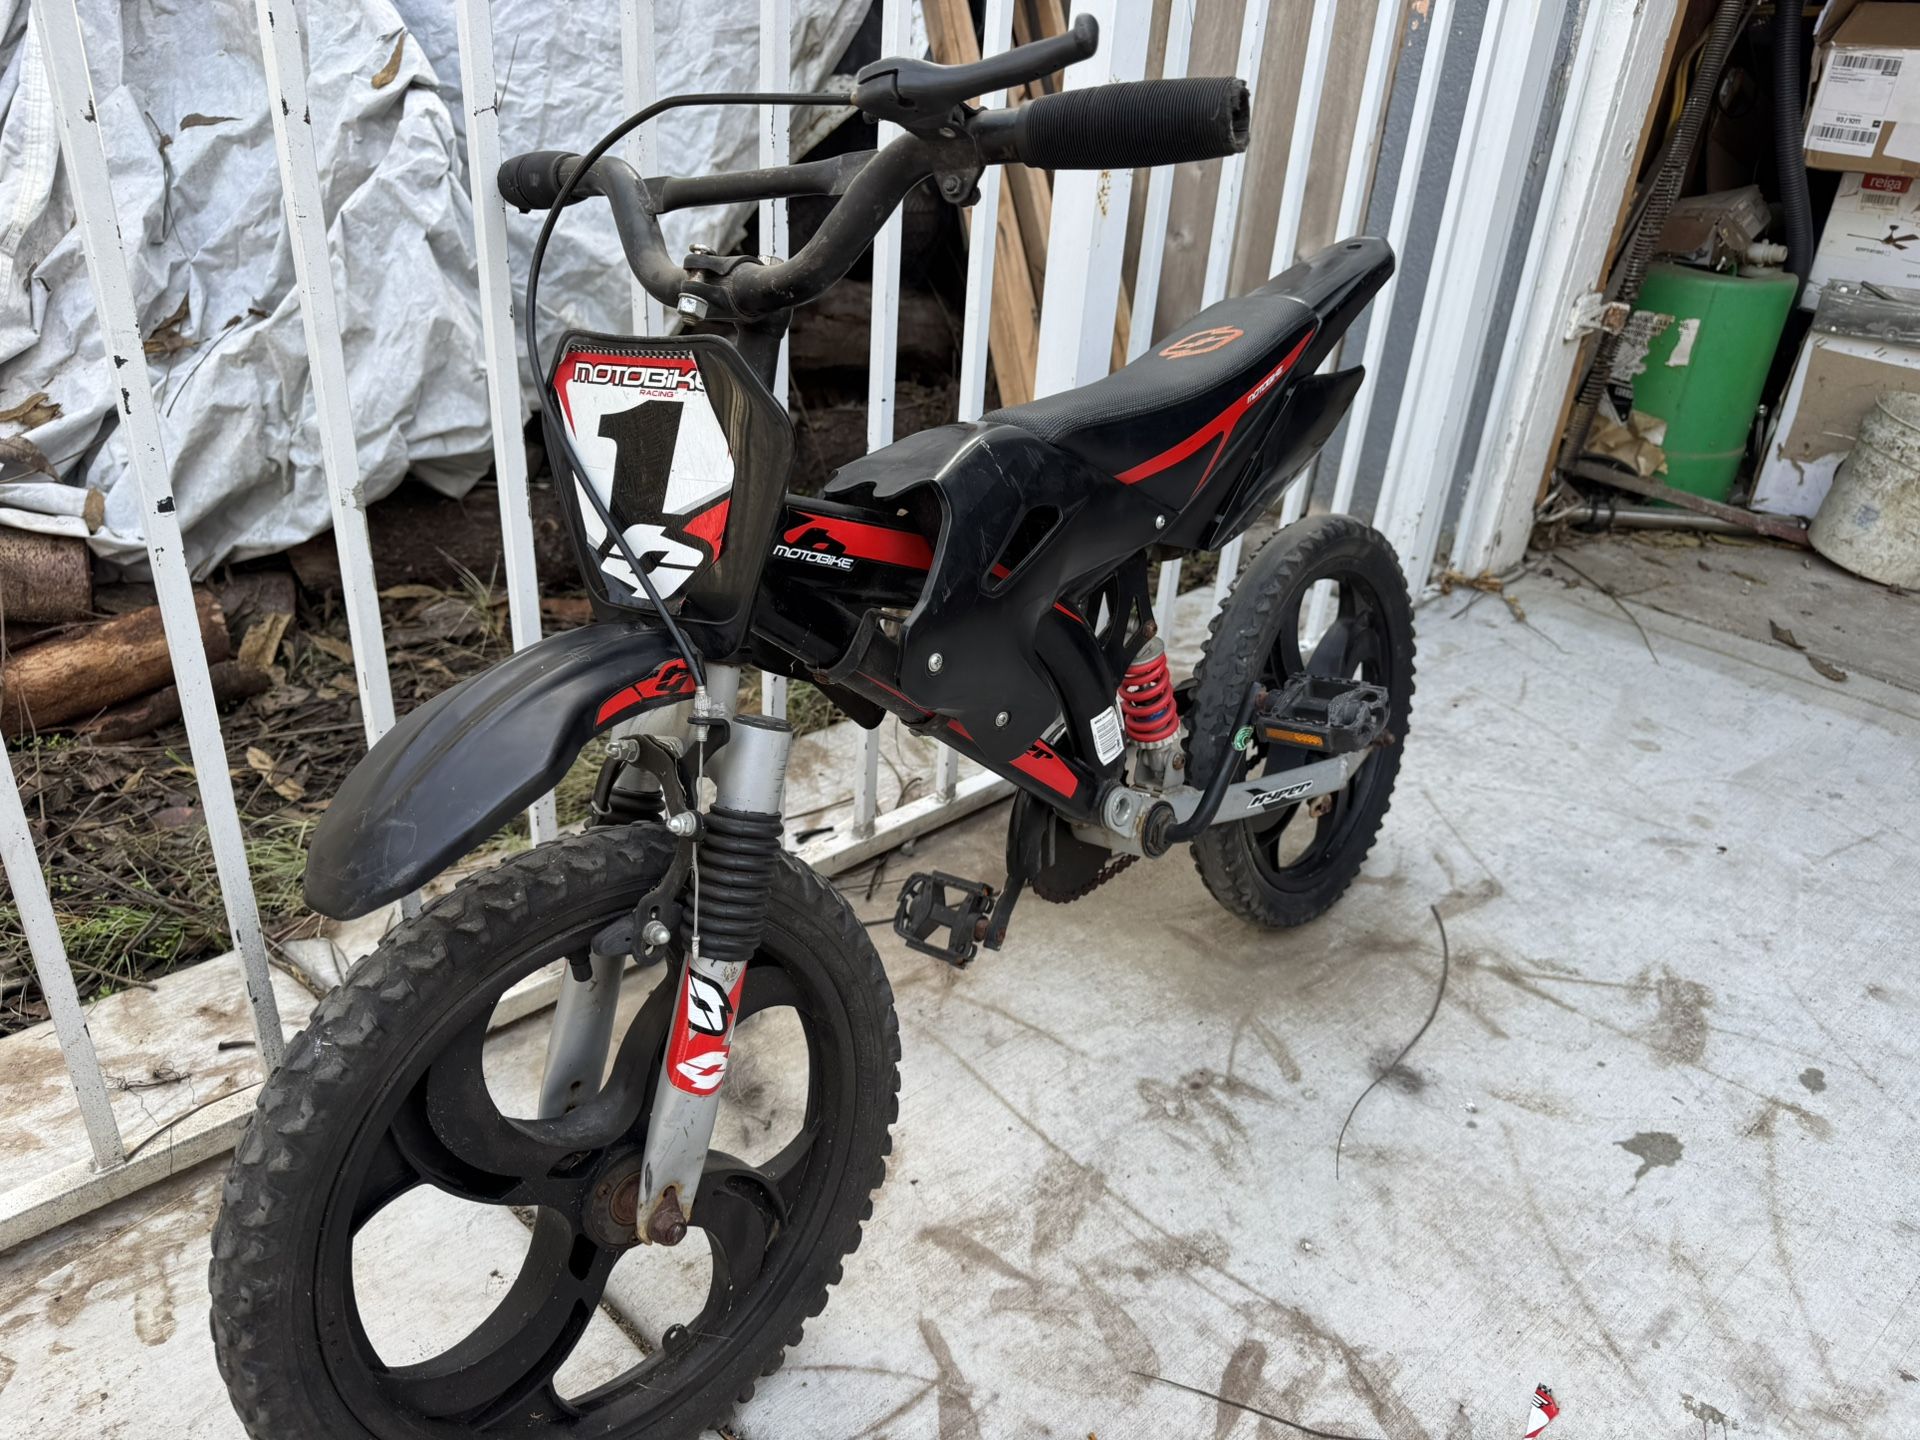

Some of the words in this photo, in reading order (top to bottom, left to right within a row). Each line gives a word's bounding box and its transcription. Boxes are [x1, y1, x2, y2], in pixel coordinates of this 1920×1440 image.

[1869, 176, 1903, 191] reiga
[639, 389, 674, 398] RACING
[597, 399, 684, 515] 1
[772, 544, 854, 570] MOTOBIKE
